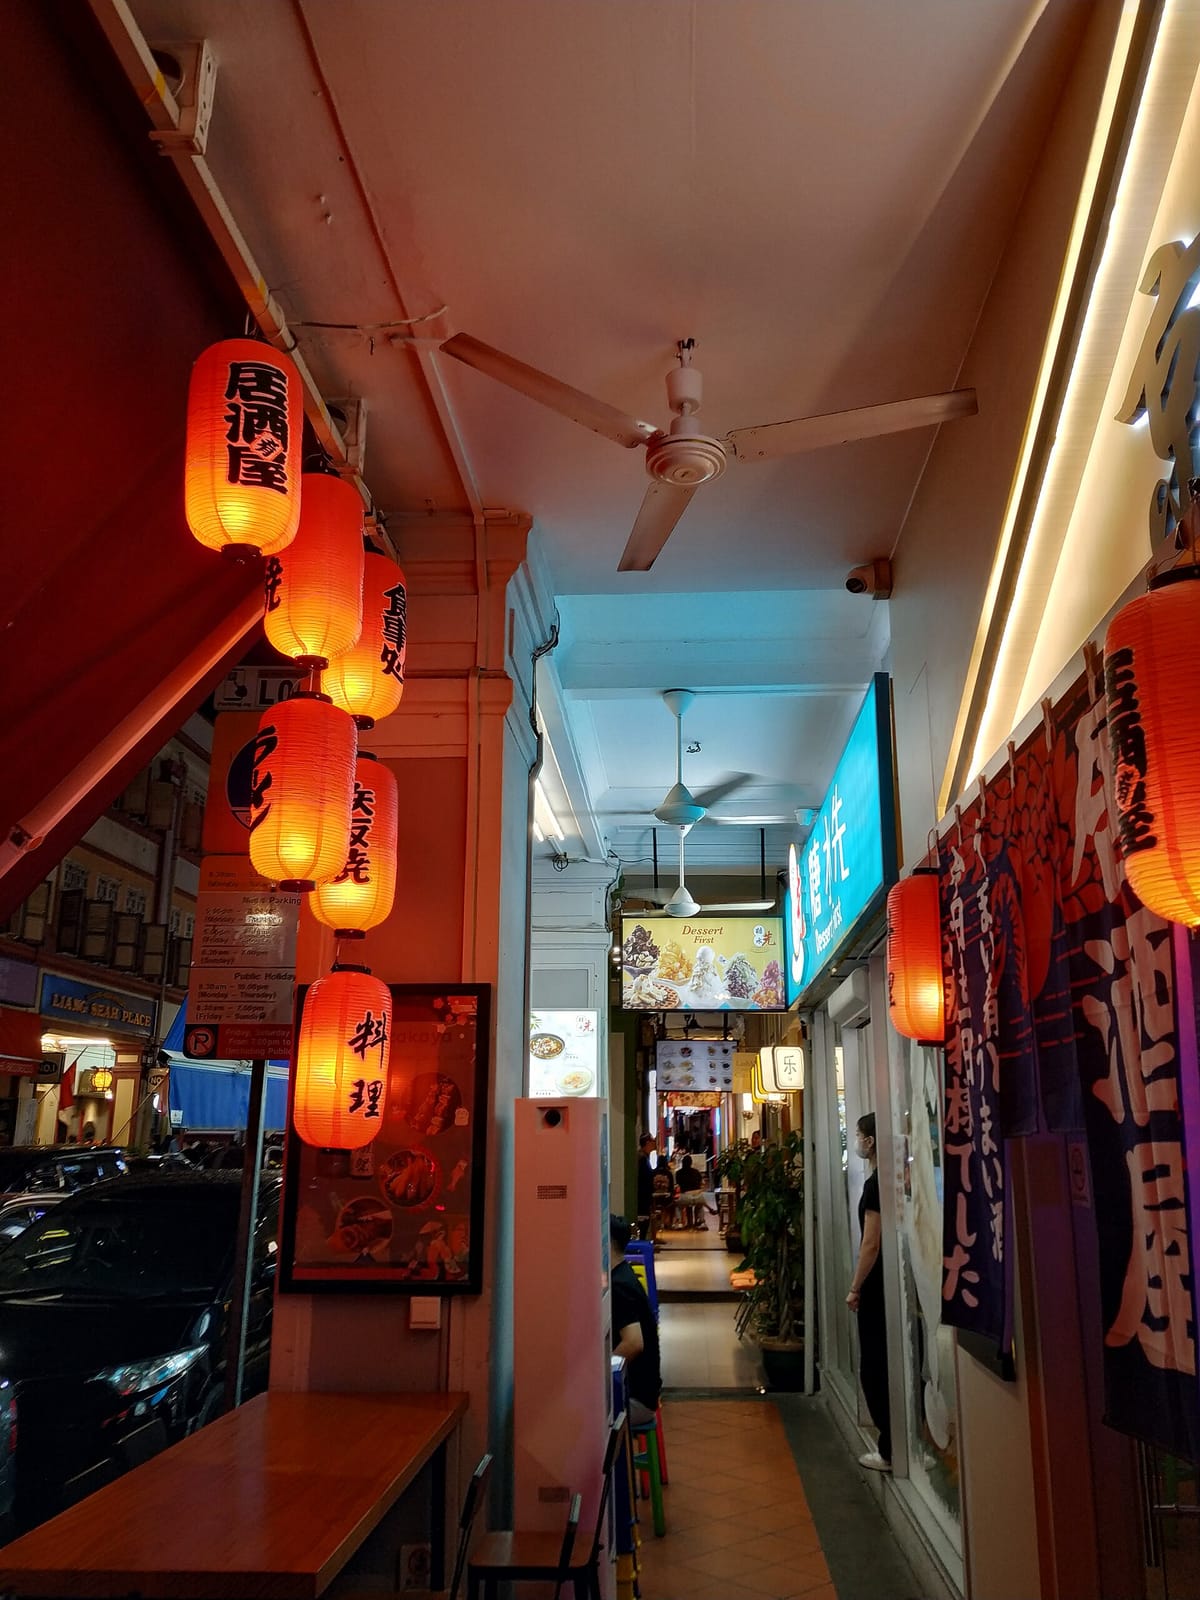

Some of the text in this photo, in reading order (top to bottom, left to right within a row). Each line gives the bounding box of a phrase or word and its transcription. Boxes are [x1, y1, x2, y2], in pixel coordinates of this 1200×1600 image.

[224, 360, 289, 495] 居酒屋
[269, 896, 302, 905] Parking
[682, 925, 724, 935] Dessert
[693, 935, 715, 944] First
[233, 972, 262, 981] Public
[90, 1002, 119, 1020] SEAH
[121, 1009, 152, 1027] PLACE
[347, 1010, 388, 1119] 料理
